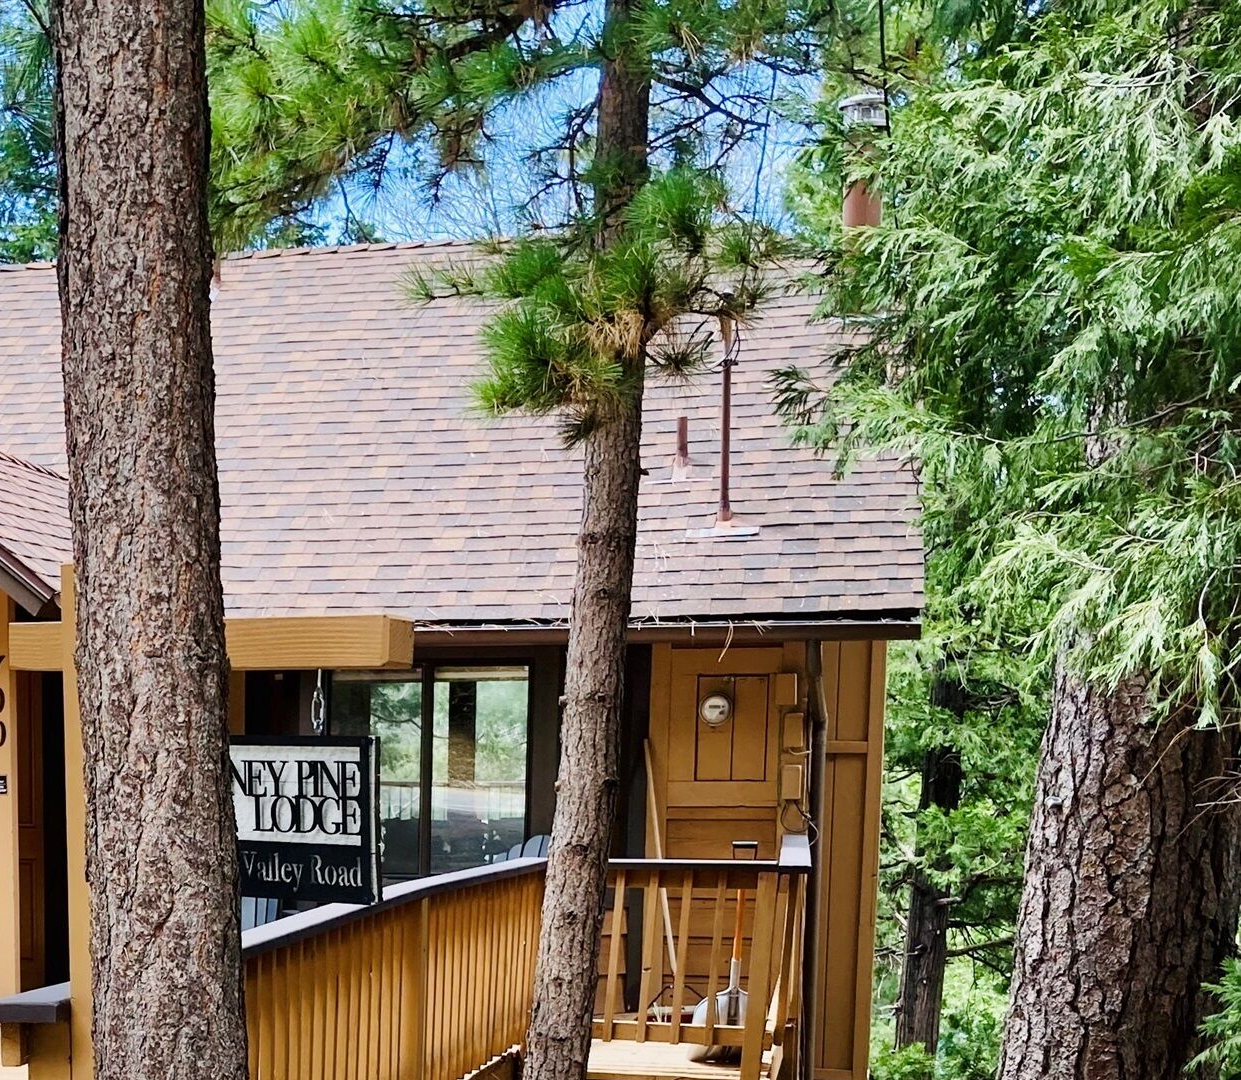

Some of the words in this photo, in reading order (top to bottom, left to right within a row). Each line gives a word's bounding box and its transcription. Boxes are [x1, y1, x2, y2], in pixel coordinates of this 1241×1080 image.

[294, 760, 361, 800] PINE
[253, 796, 362, 836] LODGE
[242, 851, 304, 892] Valley
[311, 854, 363, 888] Road
